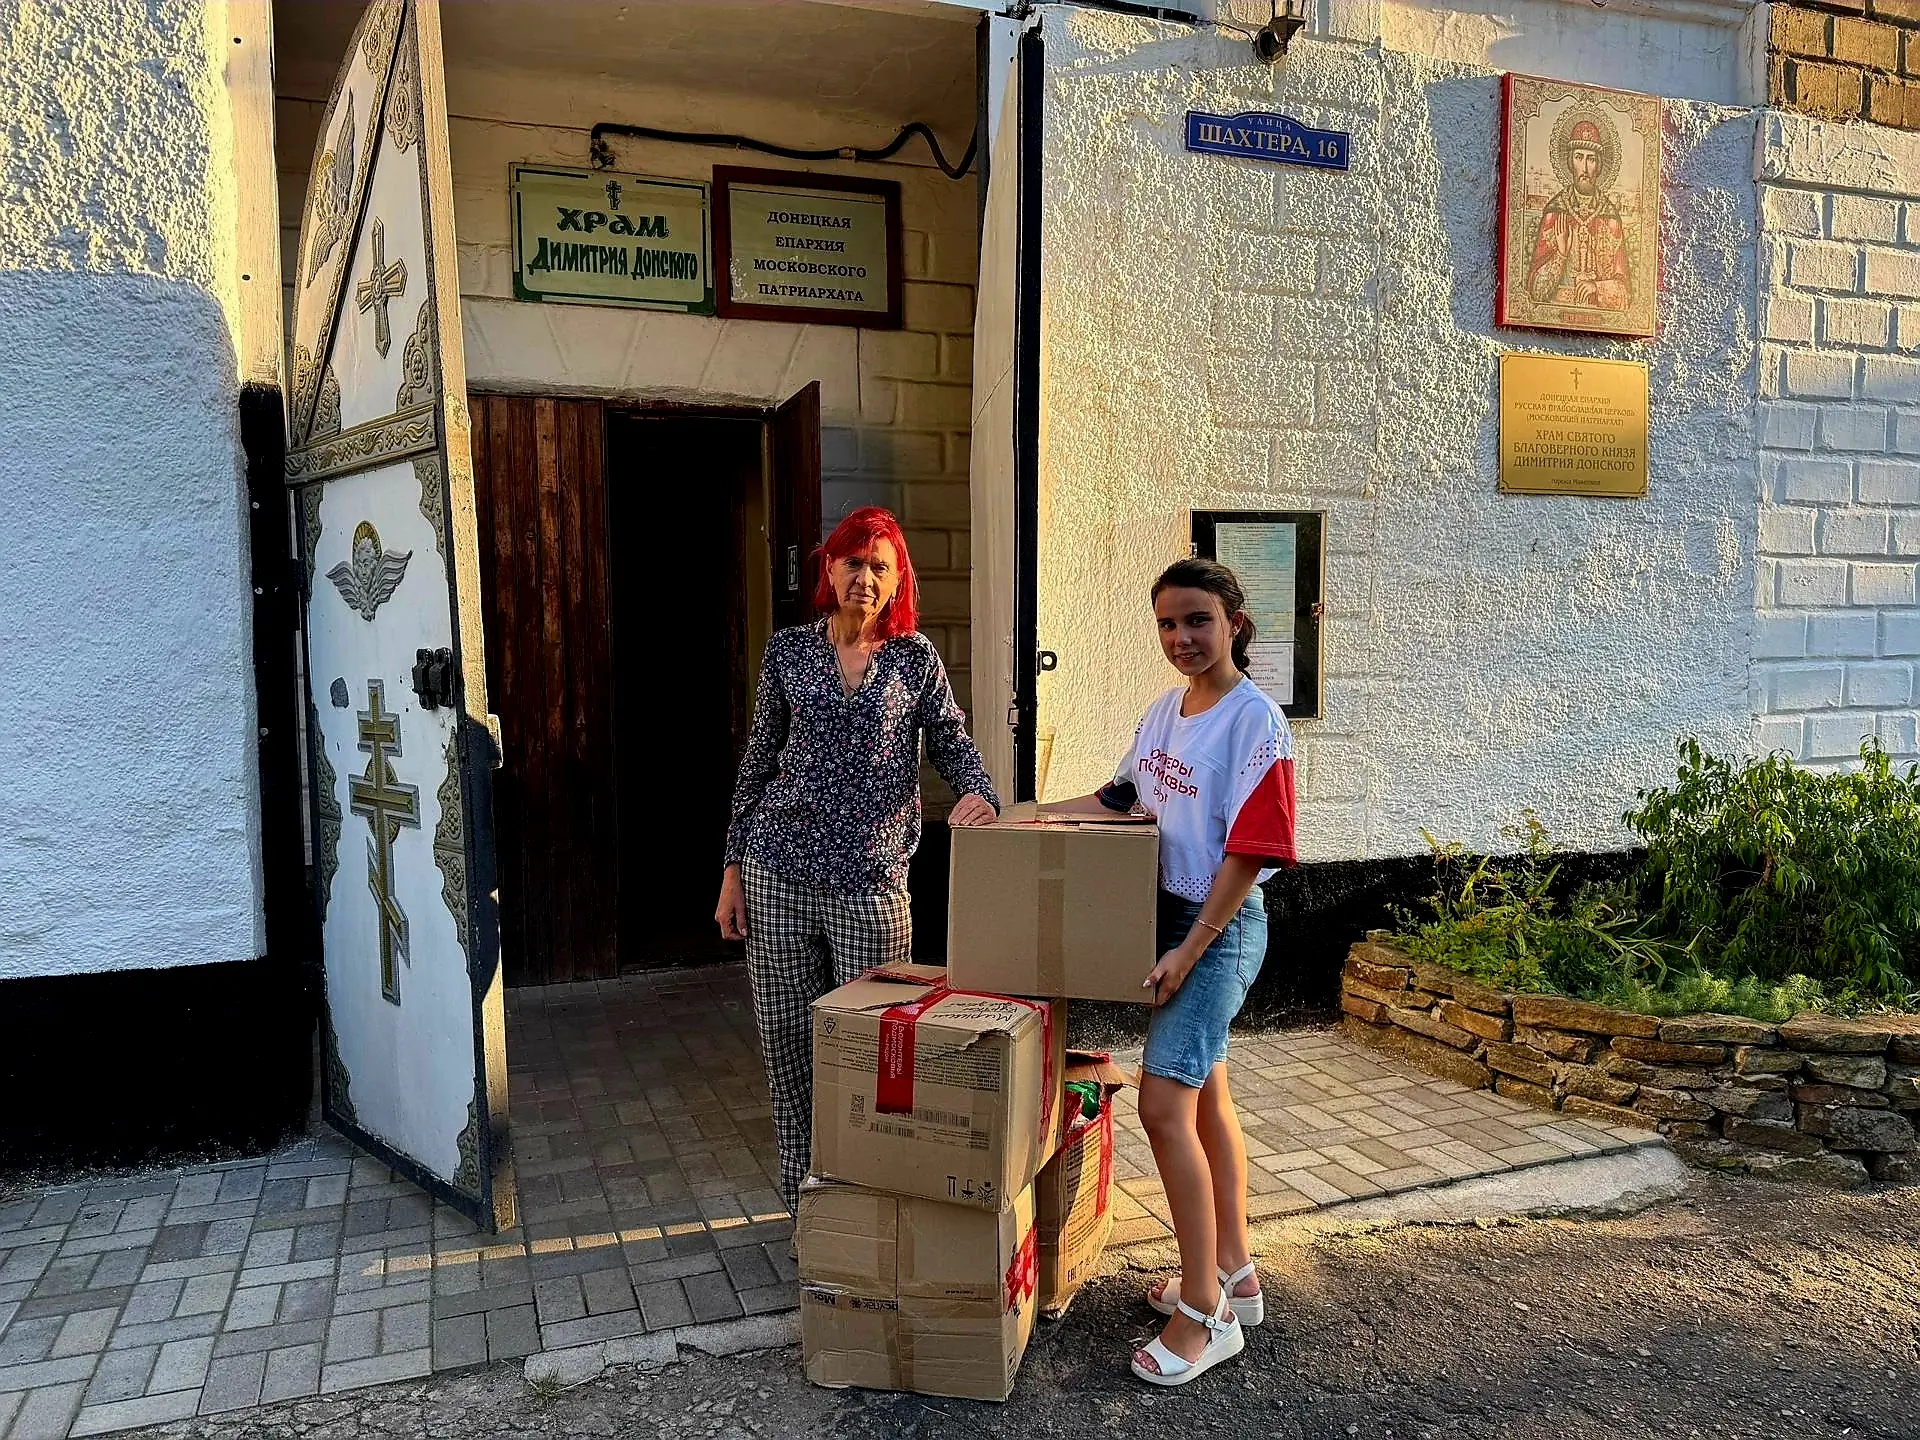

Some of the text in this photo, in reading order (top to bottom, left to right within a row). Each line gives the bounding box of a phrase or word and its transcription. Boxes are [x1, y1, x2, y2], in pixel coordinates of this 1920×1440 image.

[1248, 117, 1291, 132] УЛИЦА
[1199, 122, 1338, 159] ШАХТЕРА, 16
[767, 211, 852, 229] ДОНЕЦКАЯ
[775, 235, 845, 253] ЕПАРХИЯ
[753, 258, 867, 279] МОСКОВСКОГО
[758, 283, 865, 302] ПАТРИАРХАТА
[1514, 402, 1547, 412] РУССКАЯ
[1536, 429, 1616, 444] ХРАМ СВЯТОГО
[1513, 442, 1636, 459] БЛАГОВЕРНОГО КНЯЗЯ
[1513, 456, 1635, 472] ДИМИТРИЯ ДОНСКОГО
